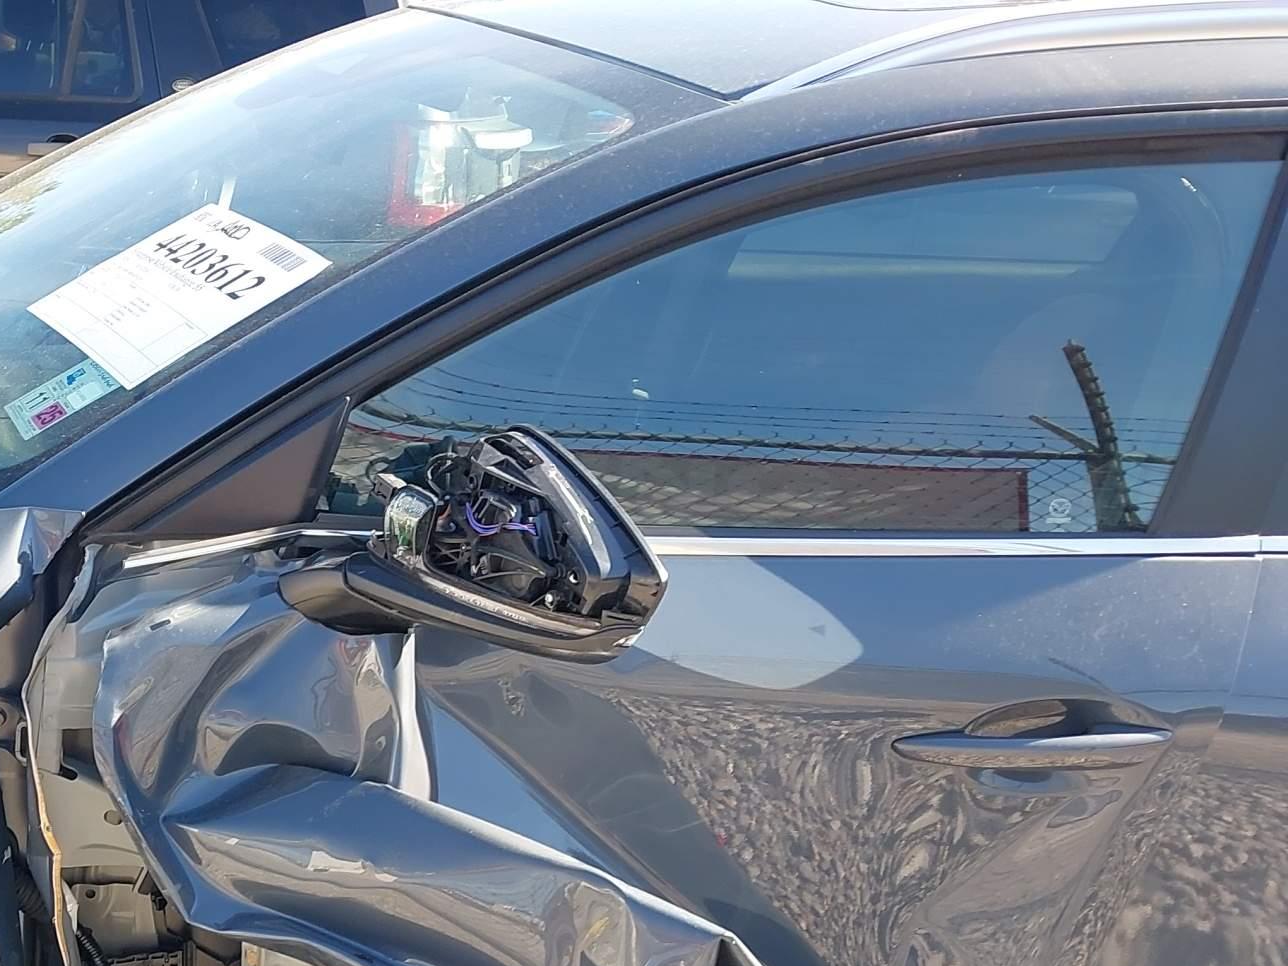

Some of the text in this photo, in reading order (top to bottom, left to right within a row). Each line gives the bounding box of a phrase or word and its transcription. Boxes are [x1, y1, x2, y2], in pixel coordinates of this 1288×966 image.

[154, 234, 266, 300] 44203612
[24, 391, 50, 410] 11
[36, 404, 64, 426] 25
